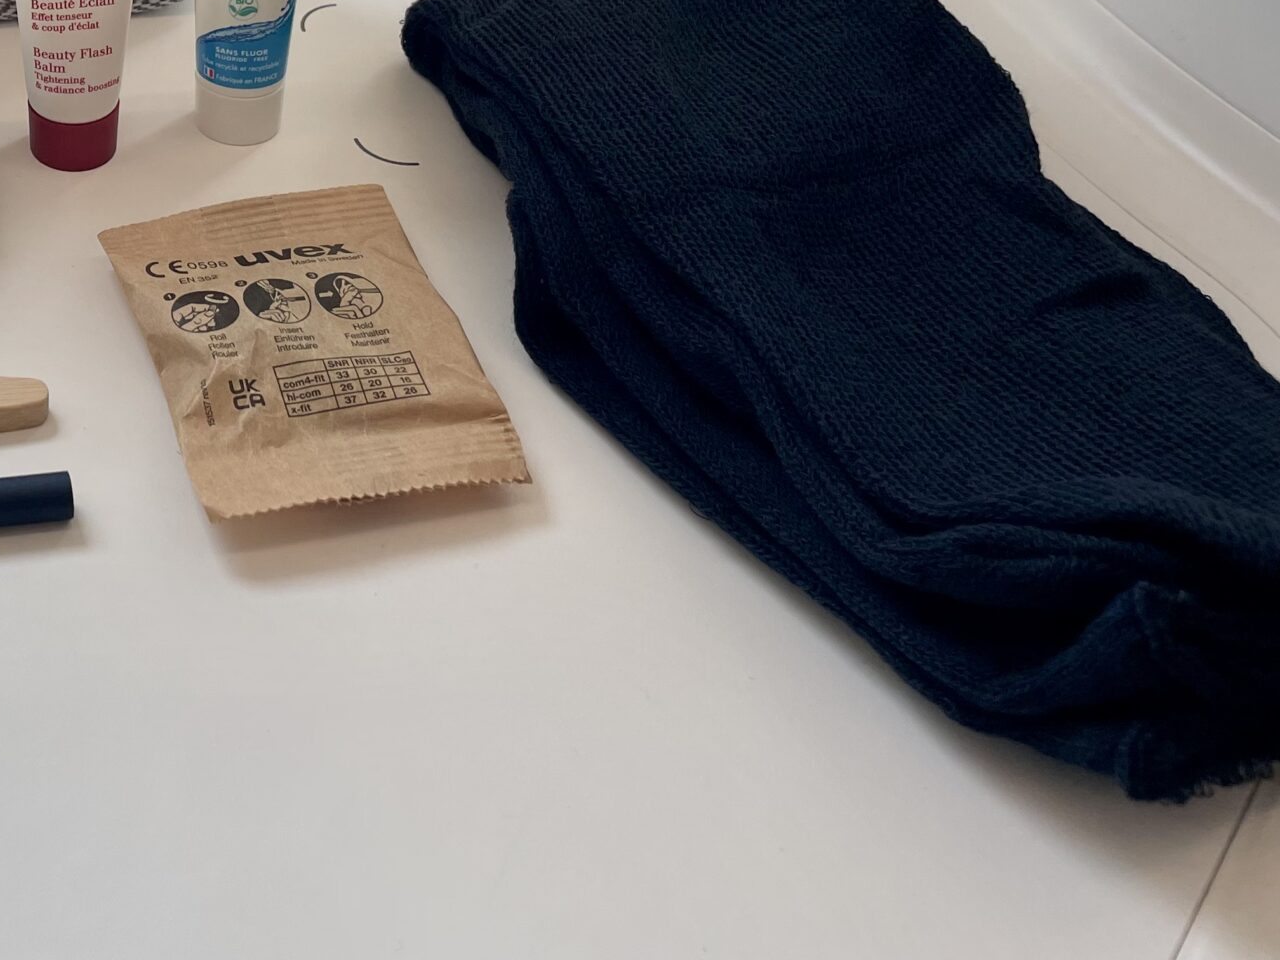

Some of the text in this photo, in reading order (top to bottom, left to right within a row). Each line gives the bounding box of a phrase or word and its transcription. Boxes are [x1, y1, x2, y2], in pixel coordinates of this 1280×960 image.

[31, 12, 93, 21] Effet tenseur
[31, 21, 99, 34] & coup d'éclat
[33, 45, 113, 62] Beauty Flash
[215, 46, 268, 57] SANS FLUOR
[34, 59, 66, 73] Balm
[34, 71, 86, 85] Tightening
[35, 81, 41, 89] &
[44, 84, 86, 94] radiance
[234, 243, 354, 267] uvex
[179, 276, 196, 285] EN
[352, 321, 373, 330] Hold
[210, 333, 227, 341] Roll
[344, 328, 390, 340] Festhalten
[208, 342, 236, 351] Rollen
[276, 342, 319, 352] Introduire
[351, 338, 390, 347] Maintenir
[327, 360, 350, 368] SNR
[354, 358, 377, 366] NRR
[283, 374, 326, 389] com4-fit
[335, 370, 350, 379] 33
[363, 368, 378, 376] 30
[228, 378, 261, 395] UK
[339, 383, 354, 391] 26
[368, 379, 382, 388] 20
[233, 393, 266, 410] CA
[291, 404, 312, 414] x-fit
[344, 395, 357, 404] 37
[373, 391, 387, 400] 32
